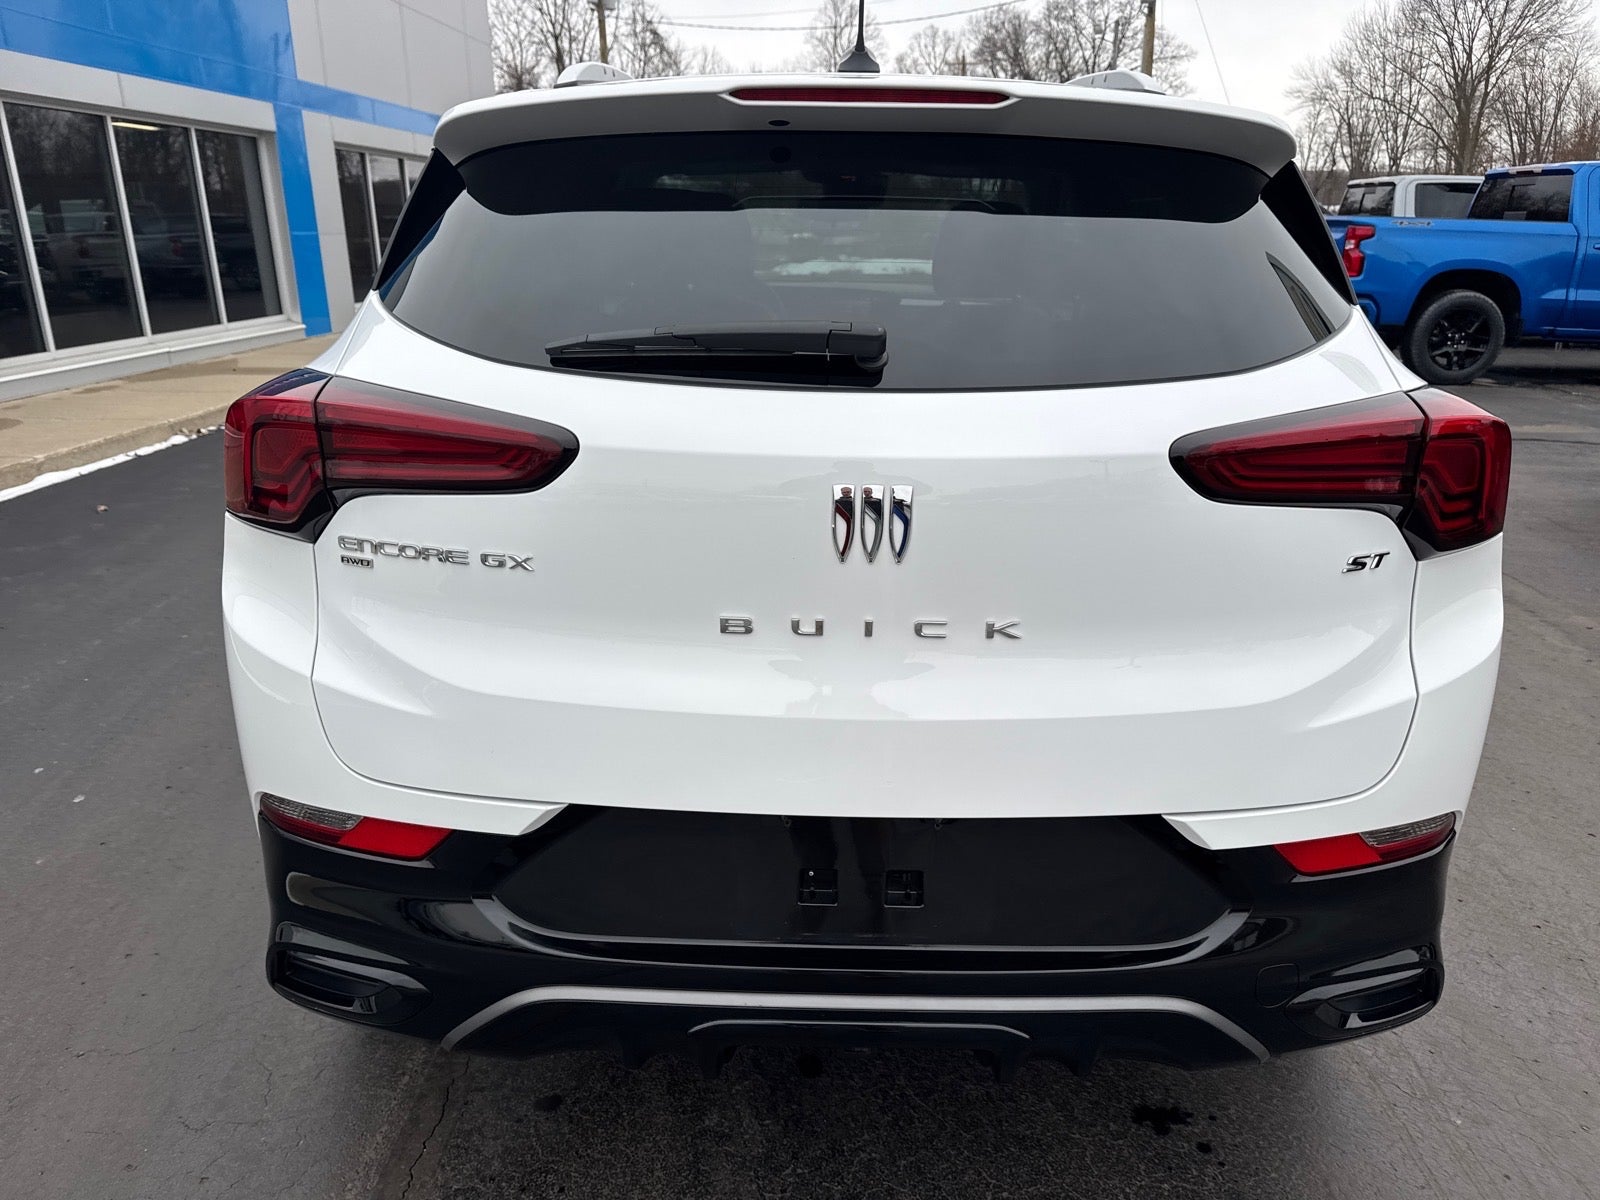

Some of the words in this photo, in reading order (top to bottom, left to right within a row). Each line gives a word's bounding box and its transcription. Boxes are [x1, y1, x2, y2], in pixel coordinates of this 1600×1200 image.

[338, 535, 470, 565] ENCORE
[480, 552, 534, 571] GX
[341, 556, 371, 567] AWD
[1342, 551, 1390, 573] ST
[720, 615, 1022, 639] BUICK
